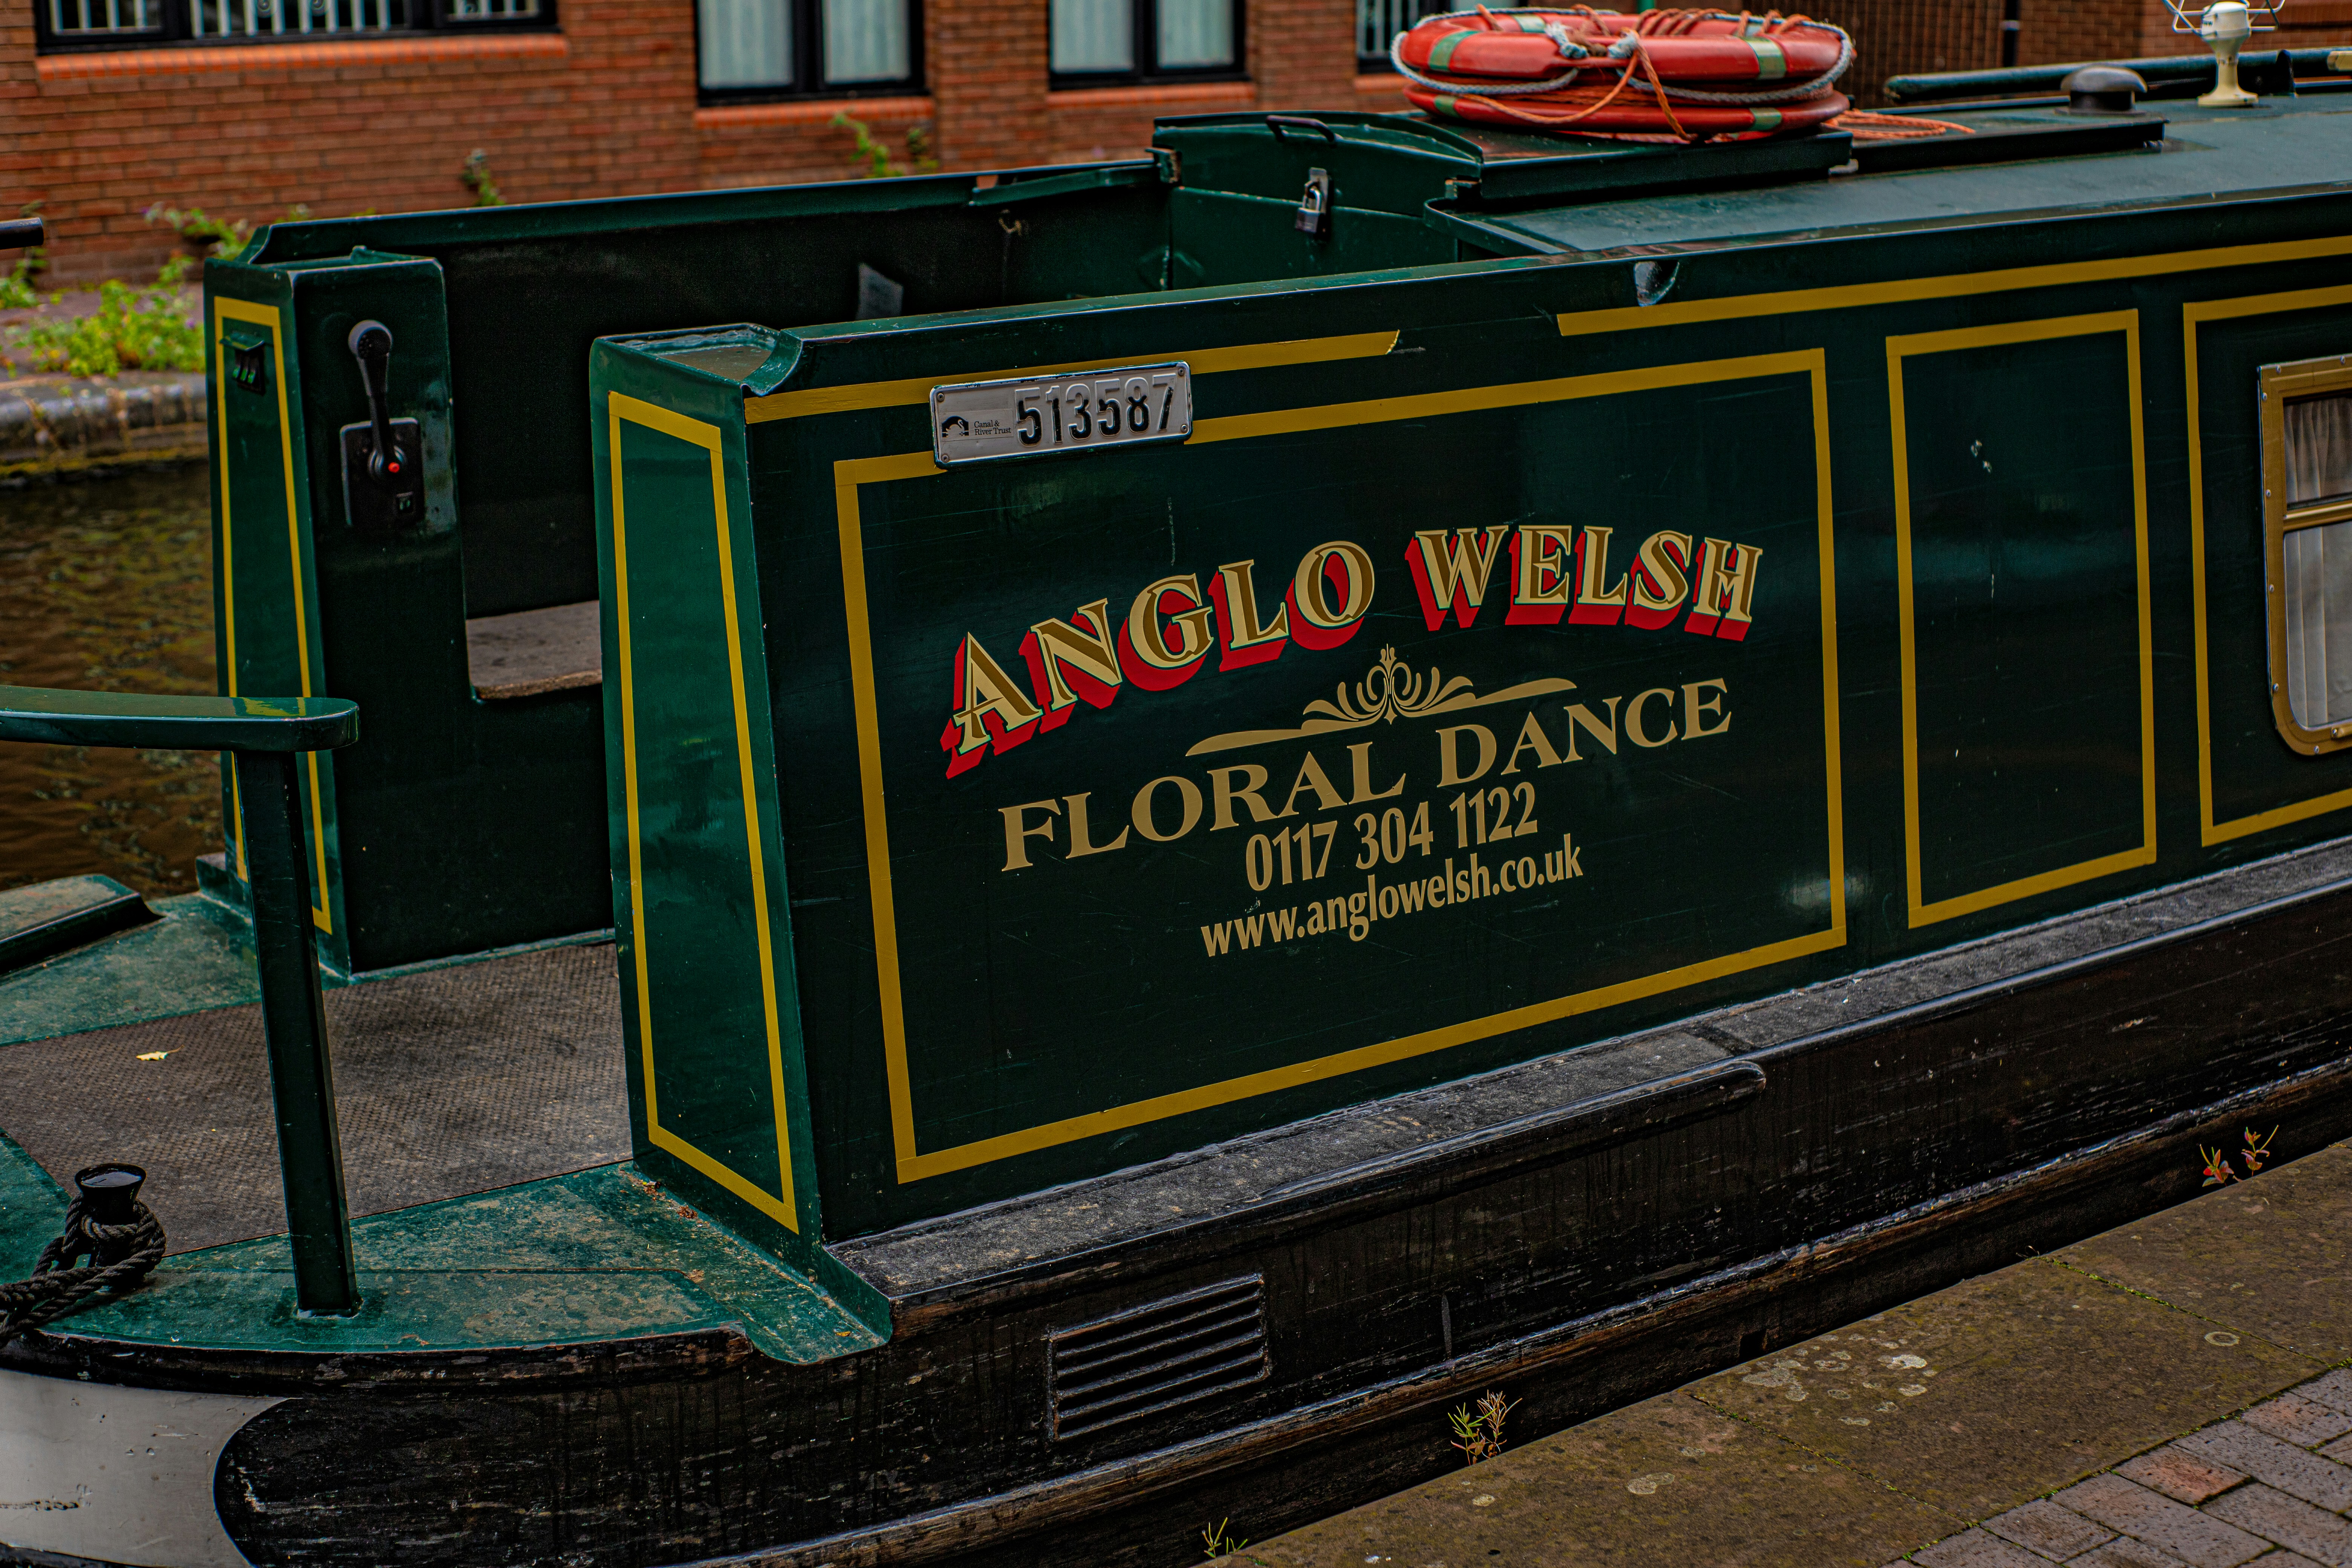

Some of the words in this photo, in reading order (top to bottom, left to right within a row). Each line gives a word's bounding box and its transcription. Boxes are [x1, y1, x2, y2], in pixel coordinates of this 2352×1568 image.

[974, 420, 993, 428] Canal
[1015, 374, 1177, 446] 513587
[941, 540, 1375, 779] ANGLO
[1405, 524, 1764, 642] WELSH
[998, 741, 1407, 872] FLORAL
[1435, 678, 1732, 788] DANCE
[1246, 820, 1338, 891] 0117
[1354, 801, 1433, 870] 304
[1449, 782, 1538, 848] 1122
[1200, 833, 1583, 957] www.anglowelsh.co.uk
